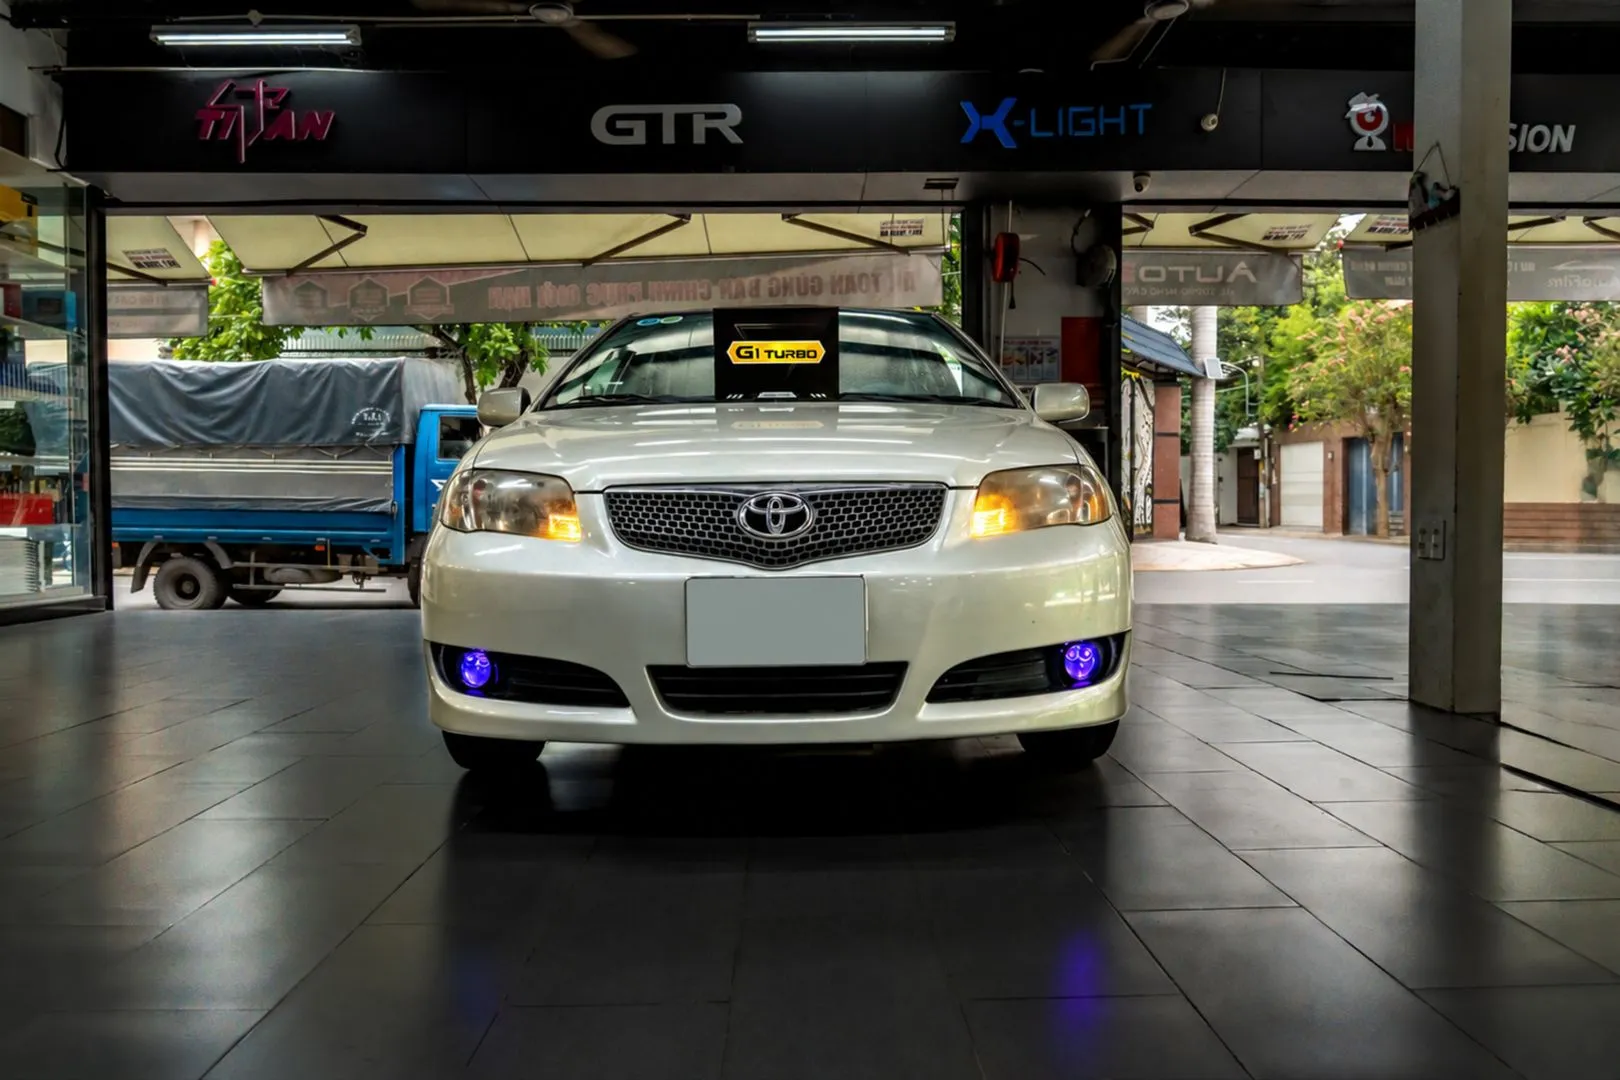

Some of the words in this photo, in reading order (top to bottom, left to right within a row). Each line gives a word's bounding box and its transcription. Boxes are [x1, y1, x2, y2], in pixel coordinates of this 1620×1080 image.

[195, 79, 336, 164] TITAN
[590, 103, 744, 145] GTR
[960, 97, 1153, 149] X-LIGHT
[764, 349, 817, 359] TURBO
